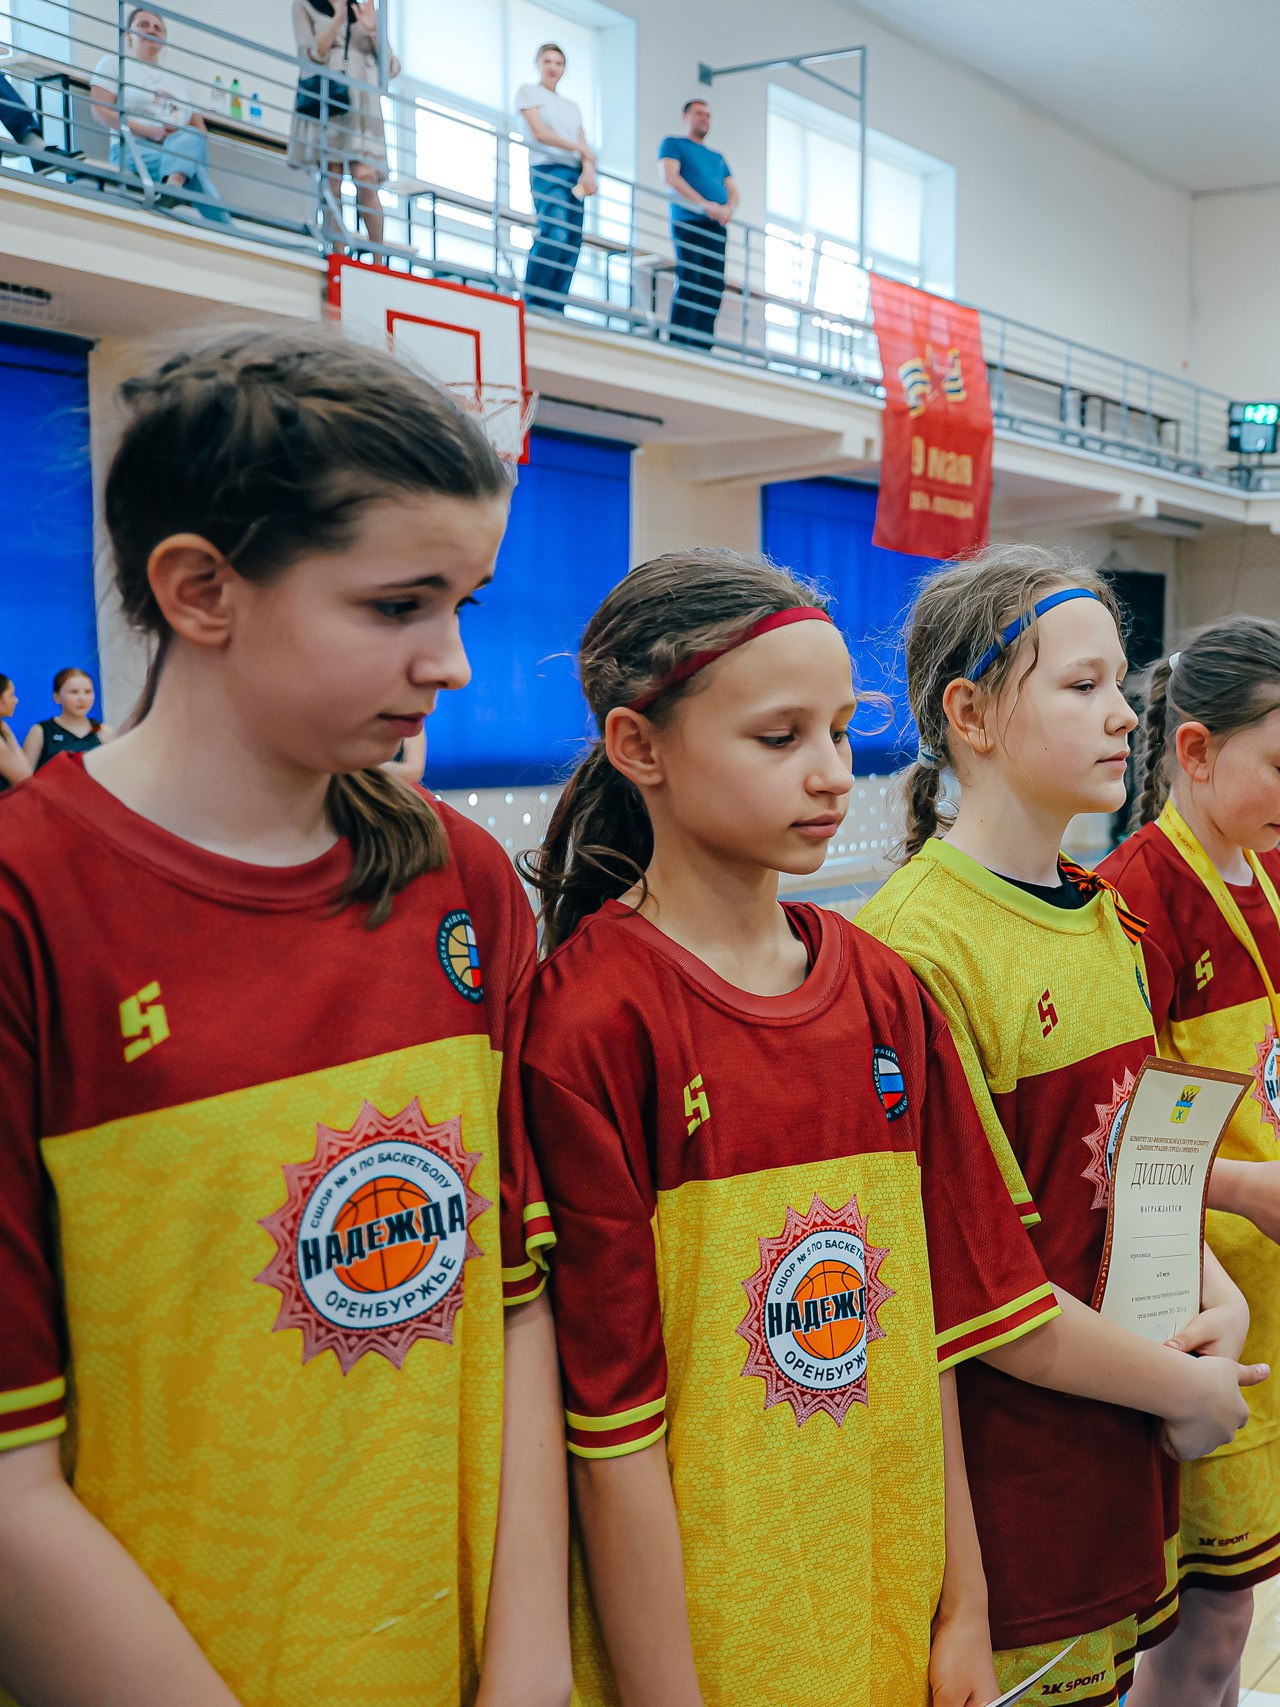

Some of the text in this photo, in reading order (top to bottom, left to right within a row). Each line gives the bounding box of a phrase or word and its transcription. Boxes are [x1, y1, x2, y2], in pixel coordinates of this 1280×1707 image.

[311, 1188, 332, 1228] СШОР
[359, 1157, 374, 1170] ПО
[378, 1152, 452, 1189] БАСКЕТБОЛУ
[1131, 1162, 1195, 1190] ДИПЛОМ
[1140, 1204, 1182, 1214] НАГРАЖДАЕТСЯ
[301, 1193, 465, 1280] НАДЕЖДА
[325, 1255, 456, 1319] ОРЕНБУРЖЬЕ
[775, 1263, 796, 1295] СШОР
[797, 1253, 807, 1264] №
[807, 1247, 812, 1255] 5
[812, 1241, 822, 1252] ПО
[1218, 1531, 1249, 1547] SPORT
[1041, 1670, 1107, 1696] 2K SPORT
